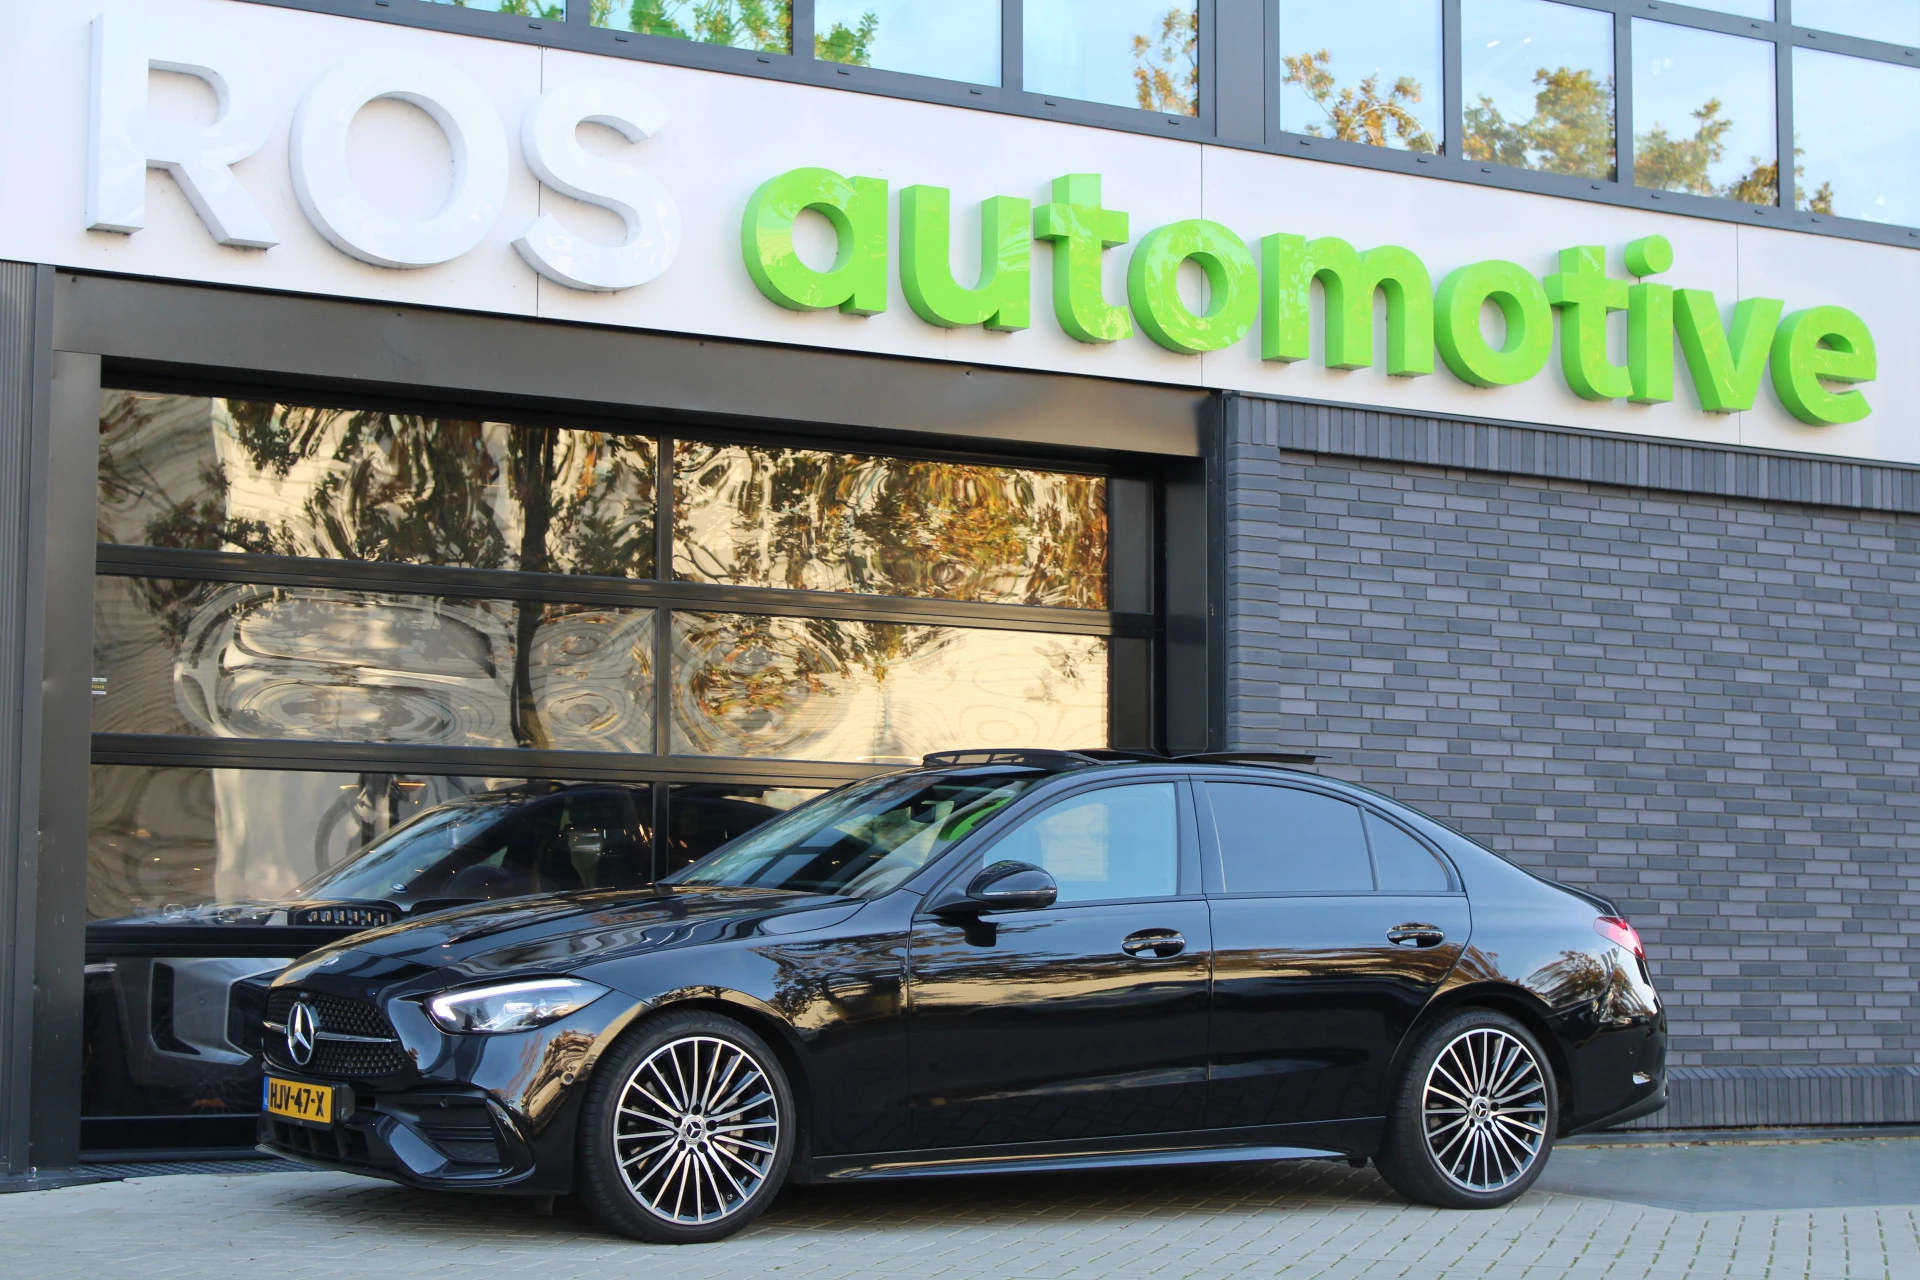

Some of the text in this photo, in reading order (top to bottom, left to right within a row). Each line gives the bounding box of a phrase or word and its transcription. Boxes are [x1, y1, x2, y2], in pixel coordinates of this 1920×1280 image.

[85, 10, 1877, 427] ROS automotive
[270, 1082, 325, 1118] HJV-47-X
